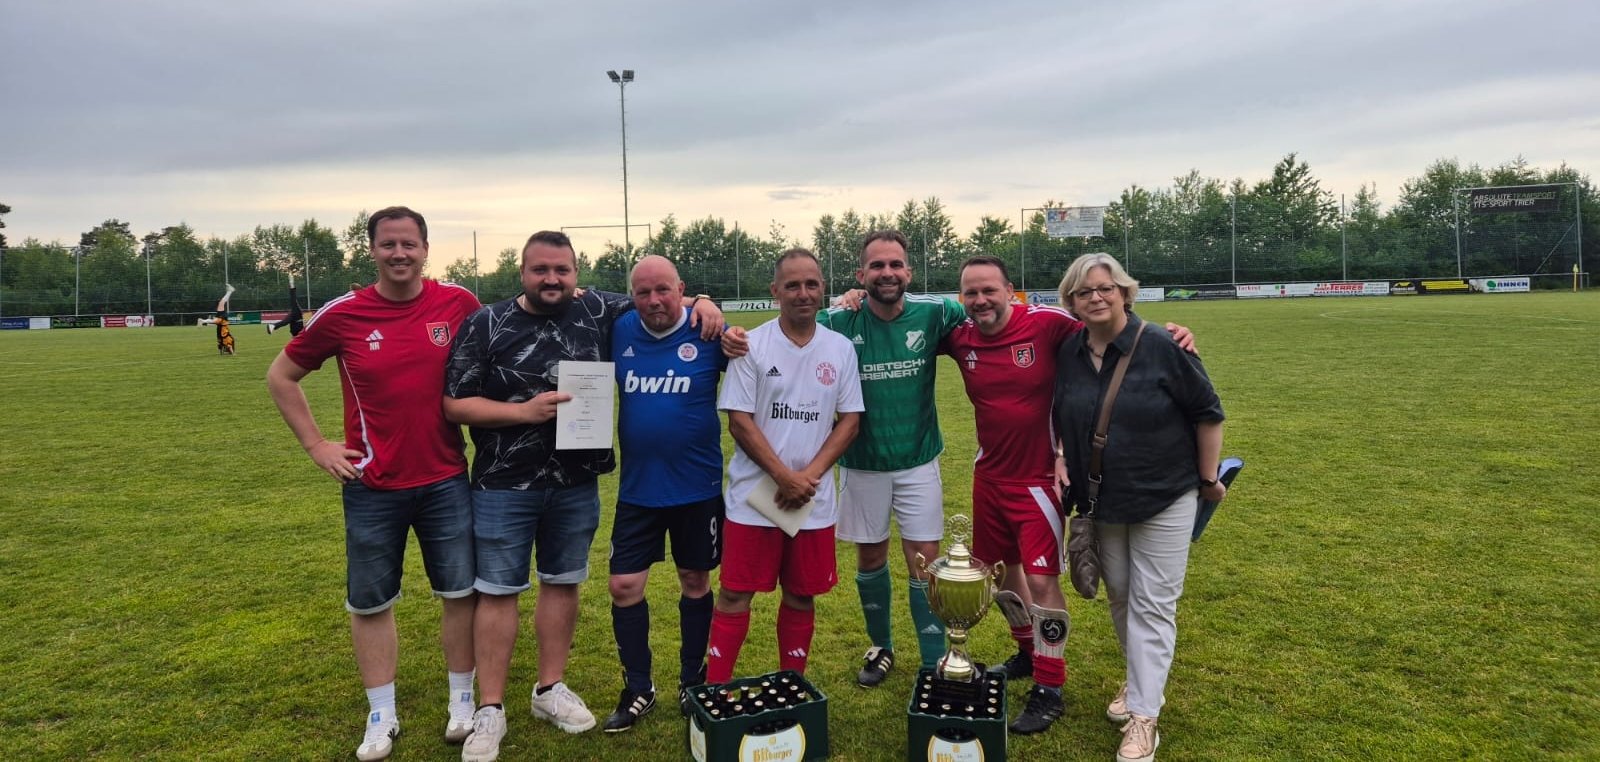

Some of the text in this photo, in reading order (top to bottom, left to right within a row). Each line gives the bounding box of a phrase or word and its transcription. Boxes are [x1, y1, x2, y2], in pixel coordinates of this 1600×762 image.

[1473, 193, 1512, 202] ABSOLUTE
[1473, 199, 1535, 209] TTS-SPORT TRIER
[862, 358, 926, 373] DIETSCH+
[624, 368, 692, 394] bwin
[771, 401, 820, 424] Bitburger
[753, 746, 793, 762] Bitburger
